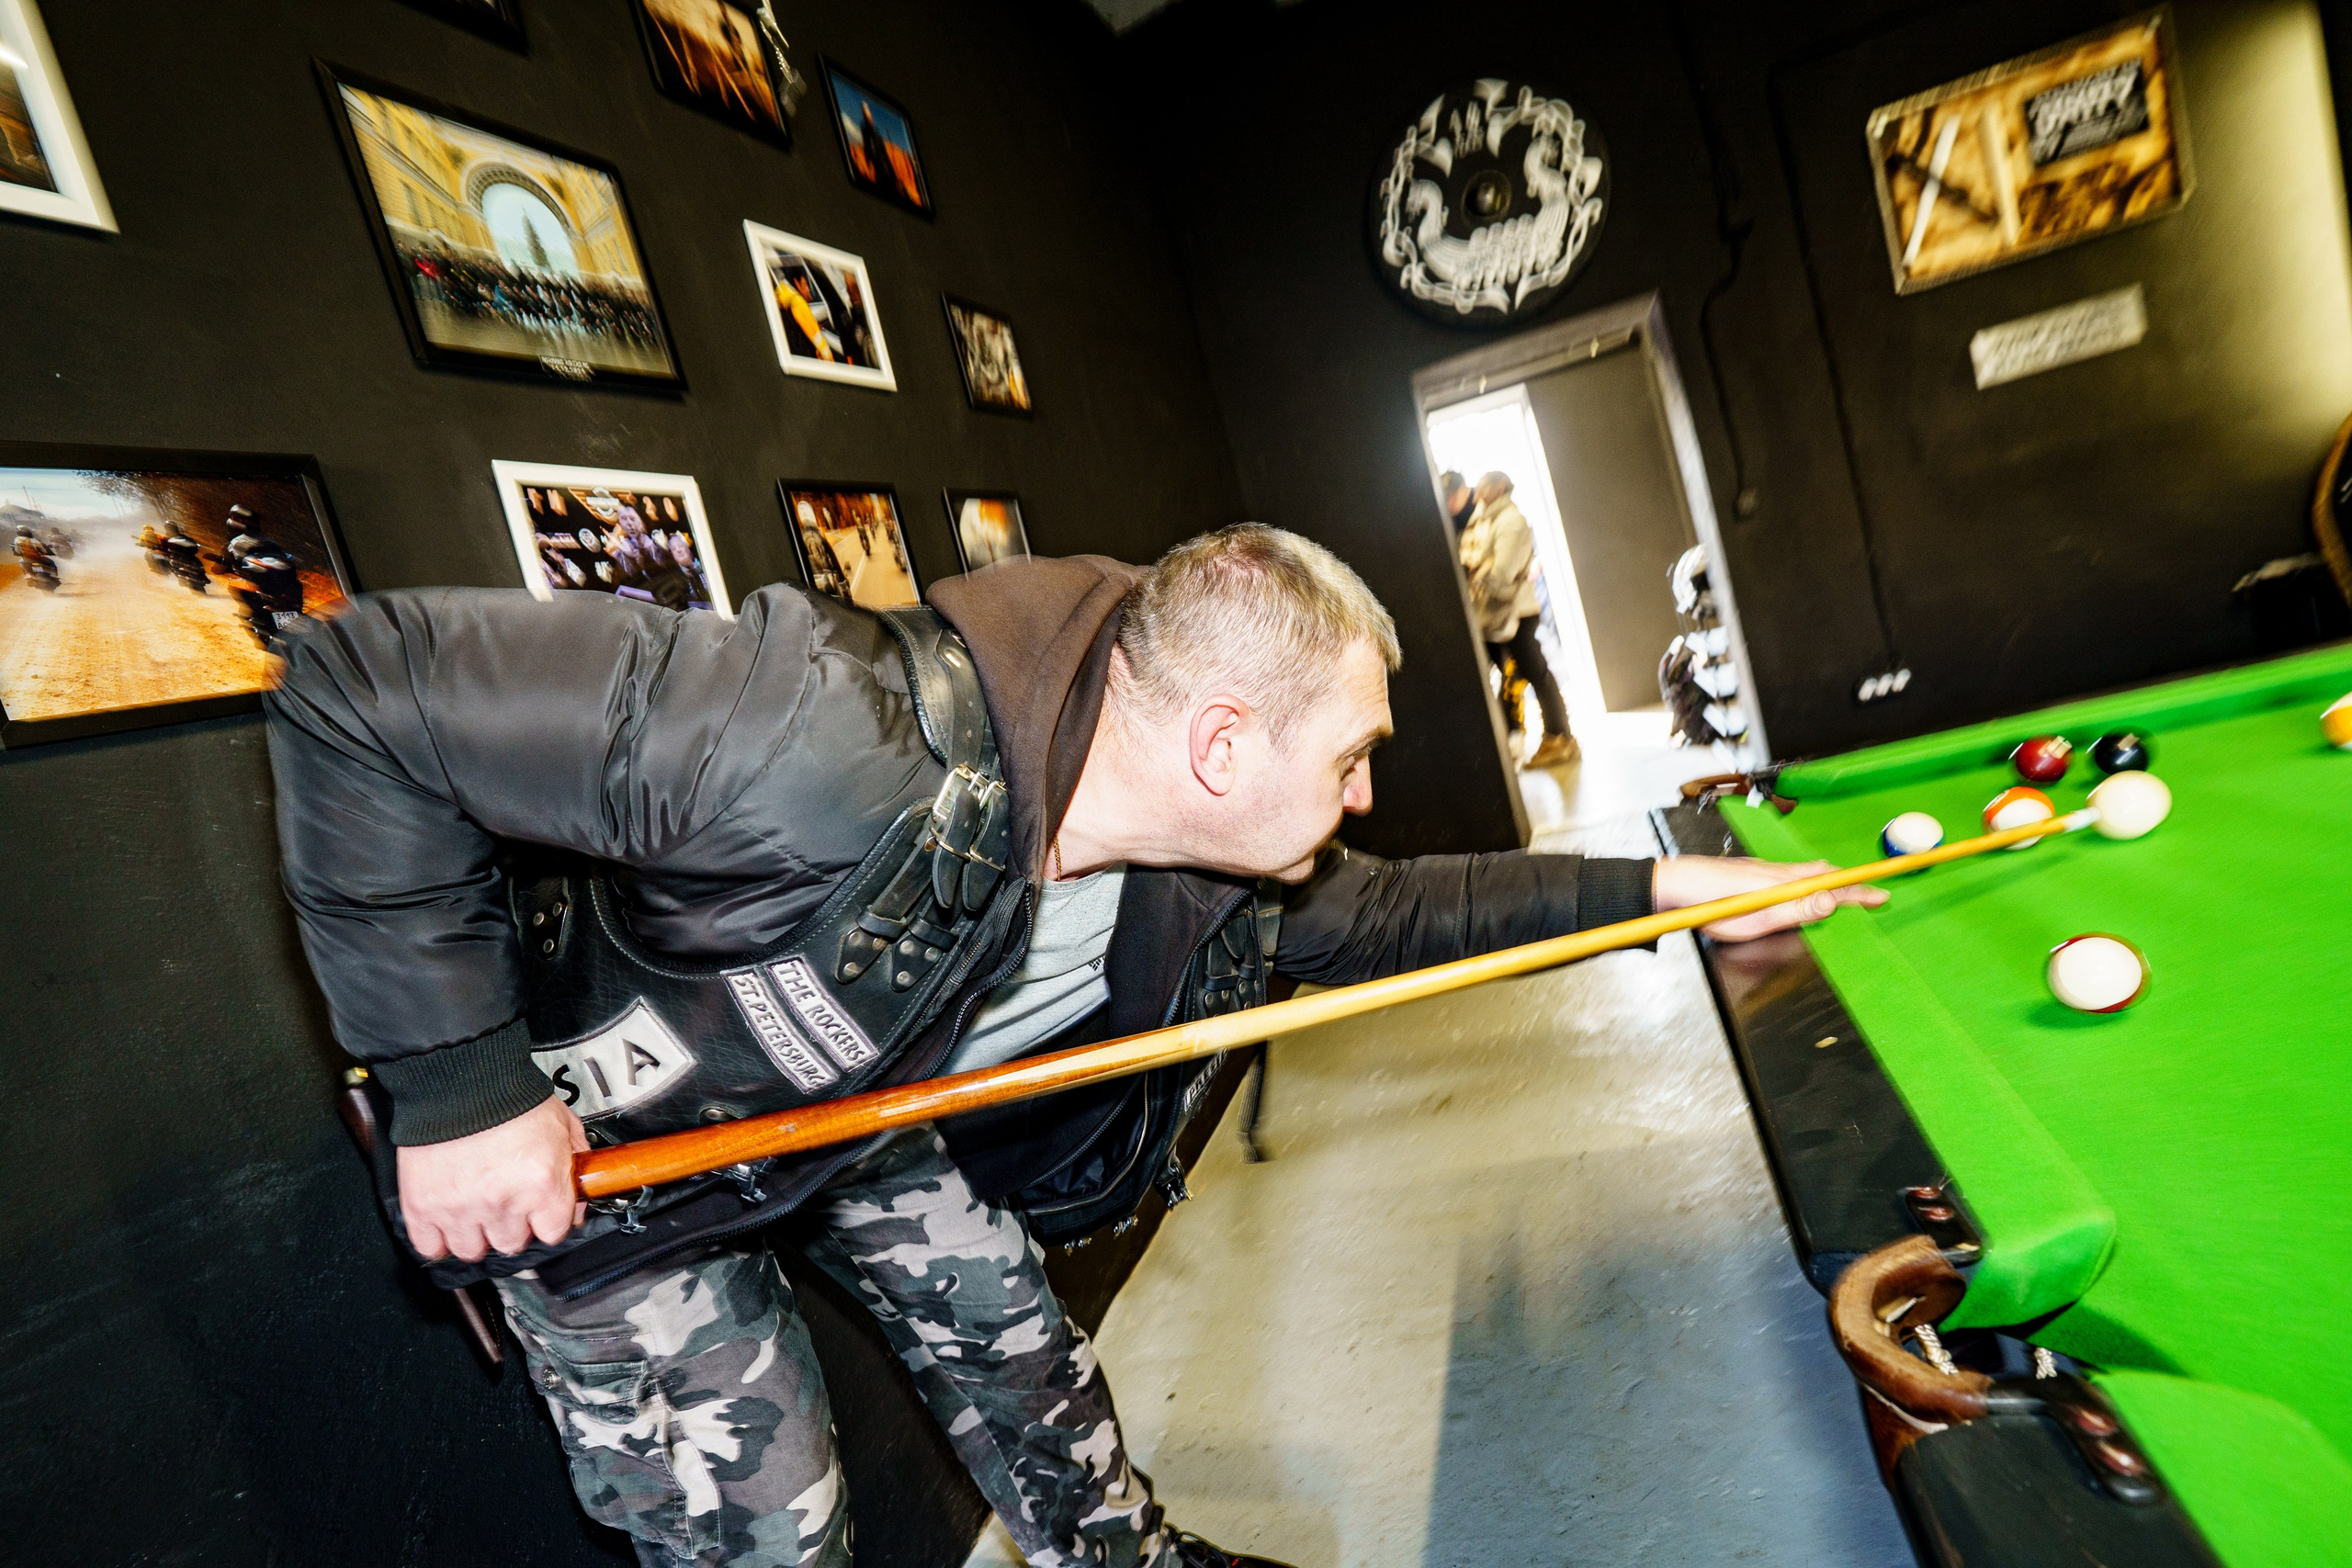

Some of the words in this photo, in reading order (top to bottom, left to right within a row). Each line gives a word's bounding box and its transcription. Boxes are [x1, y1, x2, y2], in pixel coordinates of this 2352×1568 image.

[734, 976, 826, 1085] ST.PETERSBURG
[778, 963, 816, 1002] THE
[805, 1005, 864, 1062] ROCKERS
